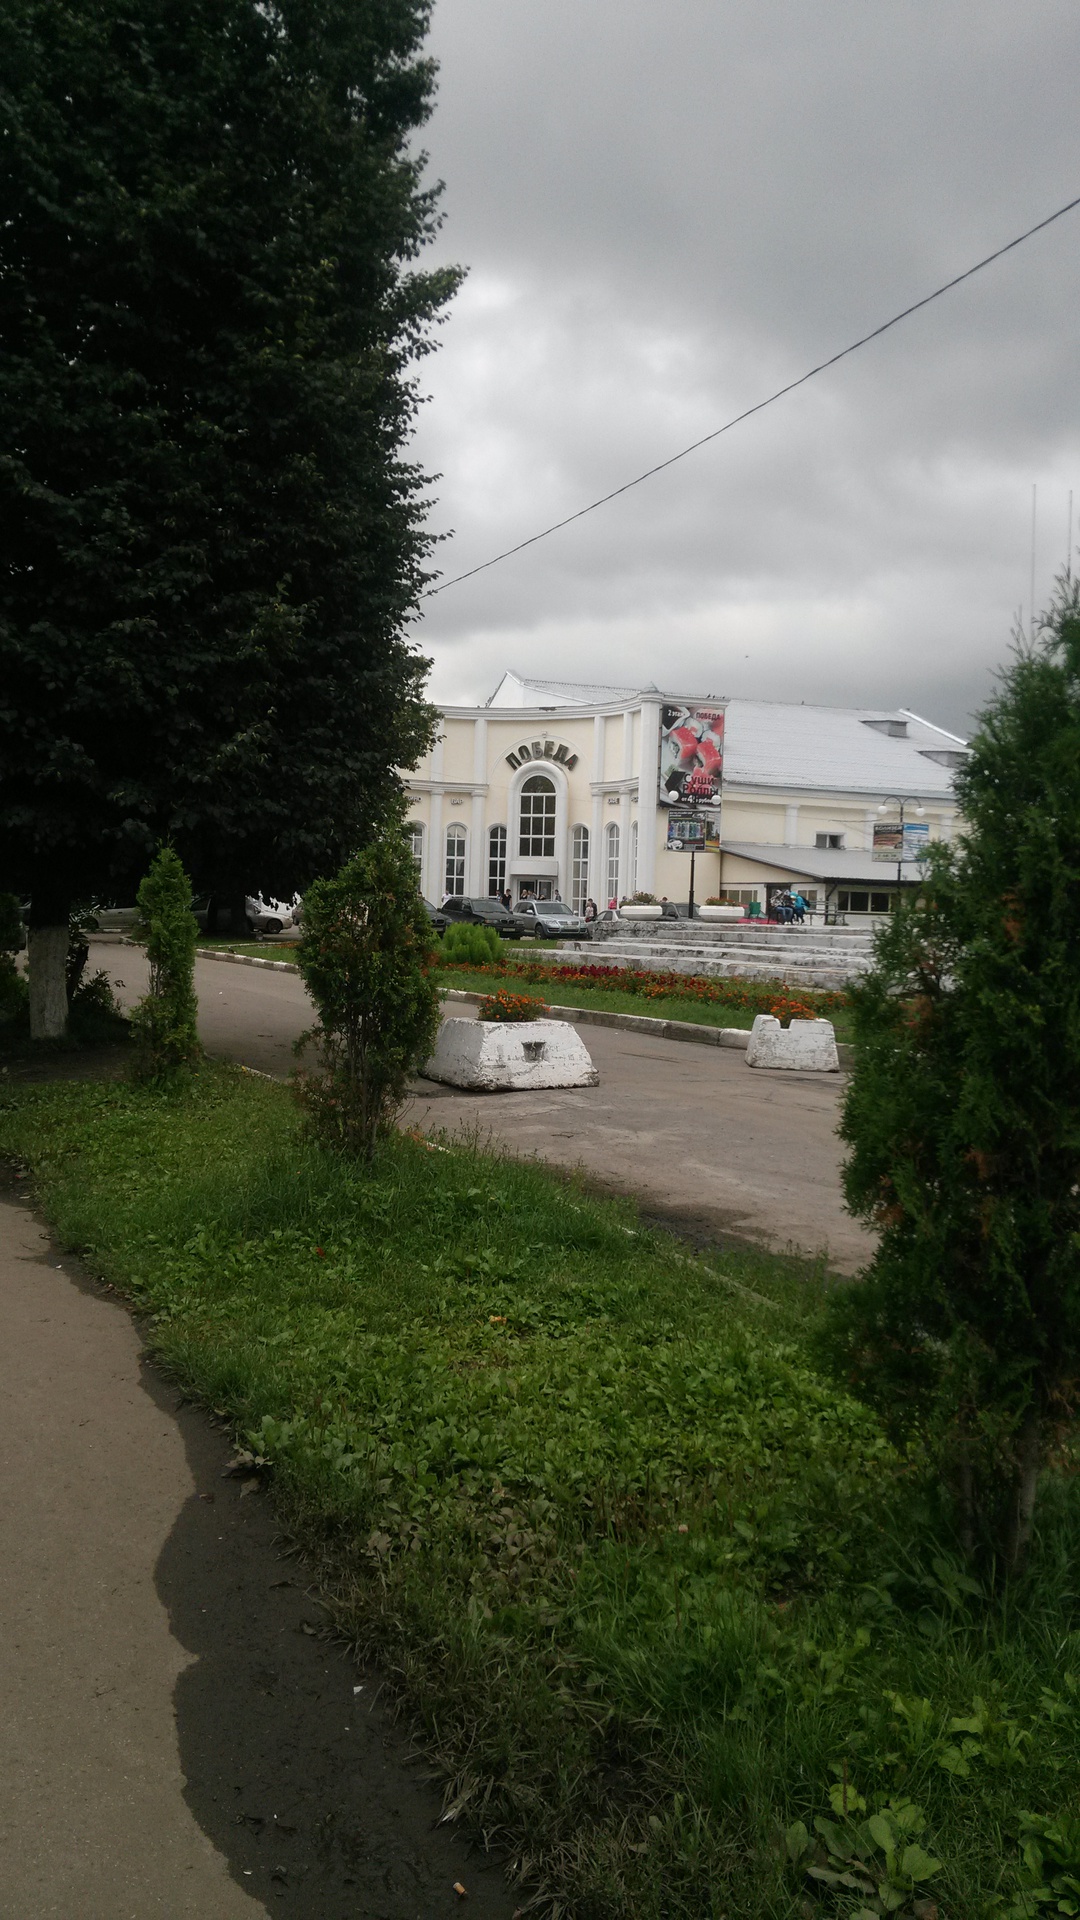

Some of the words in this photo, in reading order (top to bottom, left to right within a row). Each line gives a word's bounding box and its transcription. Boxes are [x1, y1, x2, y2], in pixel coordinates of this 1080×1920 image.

[667, 709, 672, 717] 2
[696, 712, 721, 721] ПОБЕДА
[505, 740, 579, 771] ПОБЕДА
[684, 773, 715, 785] Суши
[682, 783, 719, 795] Роллы
